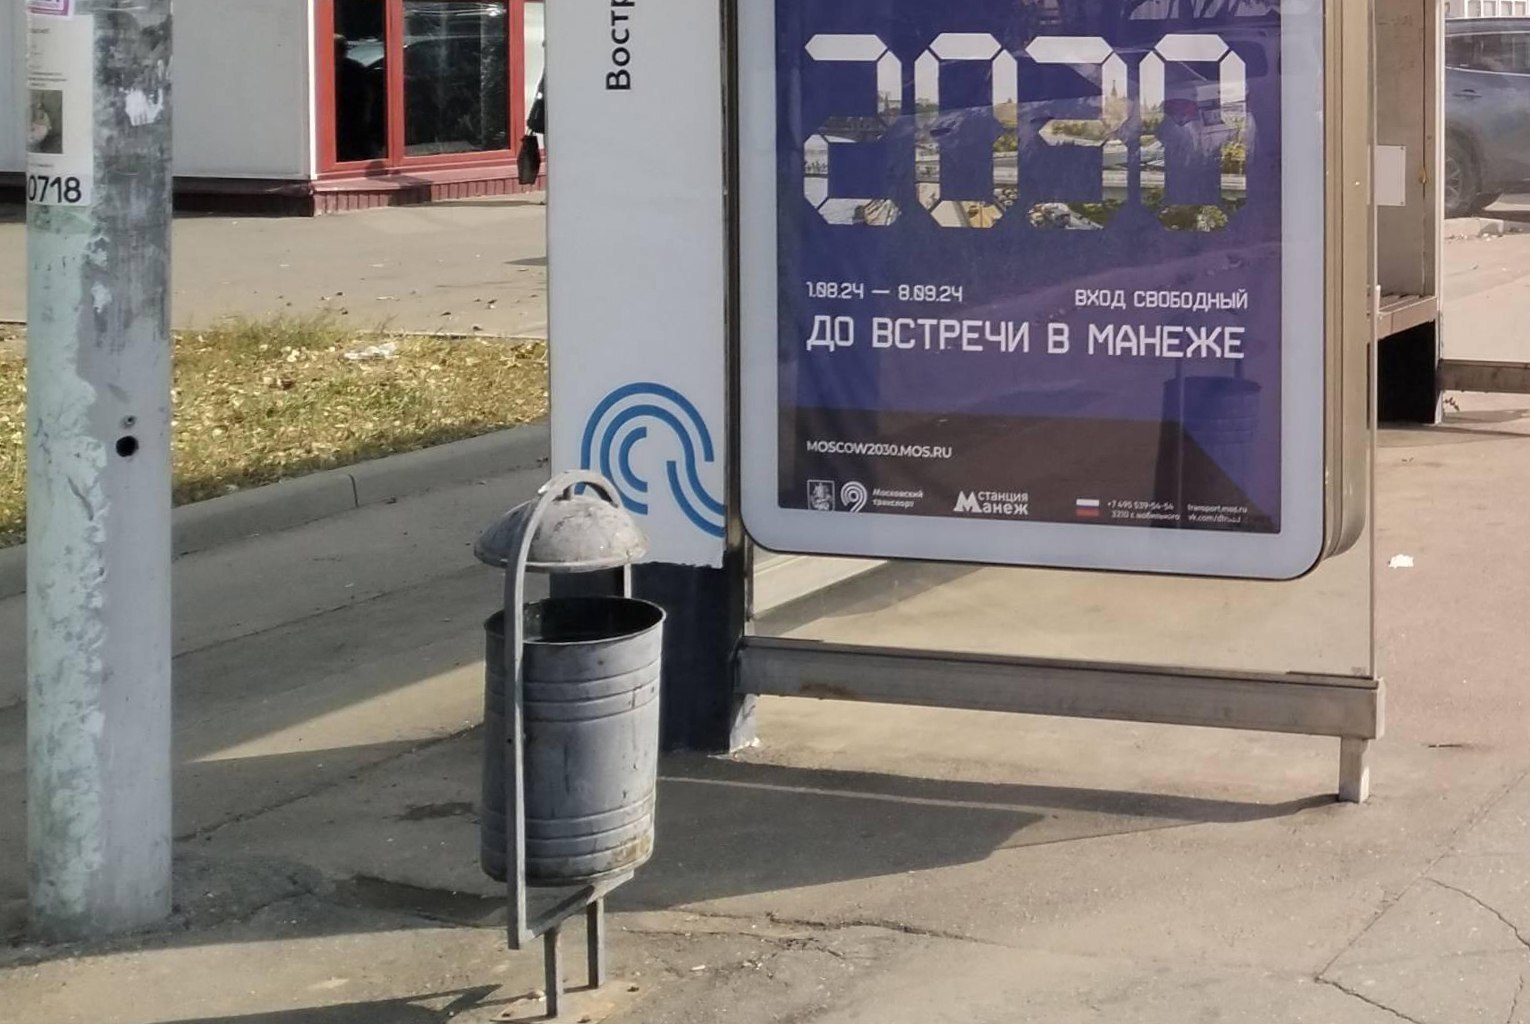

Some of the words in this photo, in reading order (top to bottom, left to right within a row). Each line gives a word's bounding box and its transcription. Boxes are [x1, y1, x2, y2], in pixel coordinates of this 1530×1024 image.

[803, 32, 1247, 232] 2030
[806, 281, 864, 299] 1.08.24
[898, 284, 963, 303] 8.09.24
[1074, 288, 1126, 310] ВХОД
[1132, 288, 1249, 312] СВОБОДНЫЙ
[806, 314, 855, 352] ДО
[871, 316, 1030, 353] ВСТРЕЧИ
[1047, 322, 1071, 354] В
[1087, 323, 1246, 359] МАНЕЖЕ
[805, 440, 953, 459] MOSCOW2030.MOS.RU
[977, 491, 1029, 503] станция
